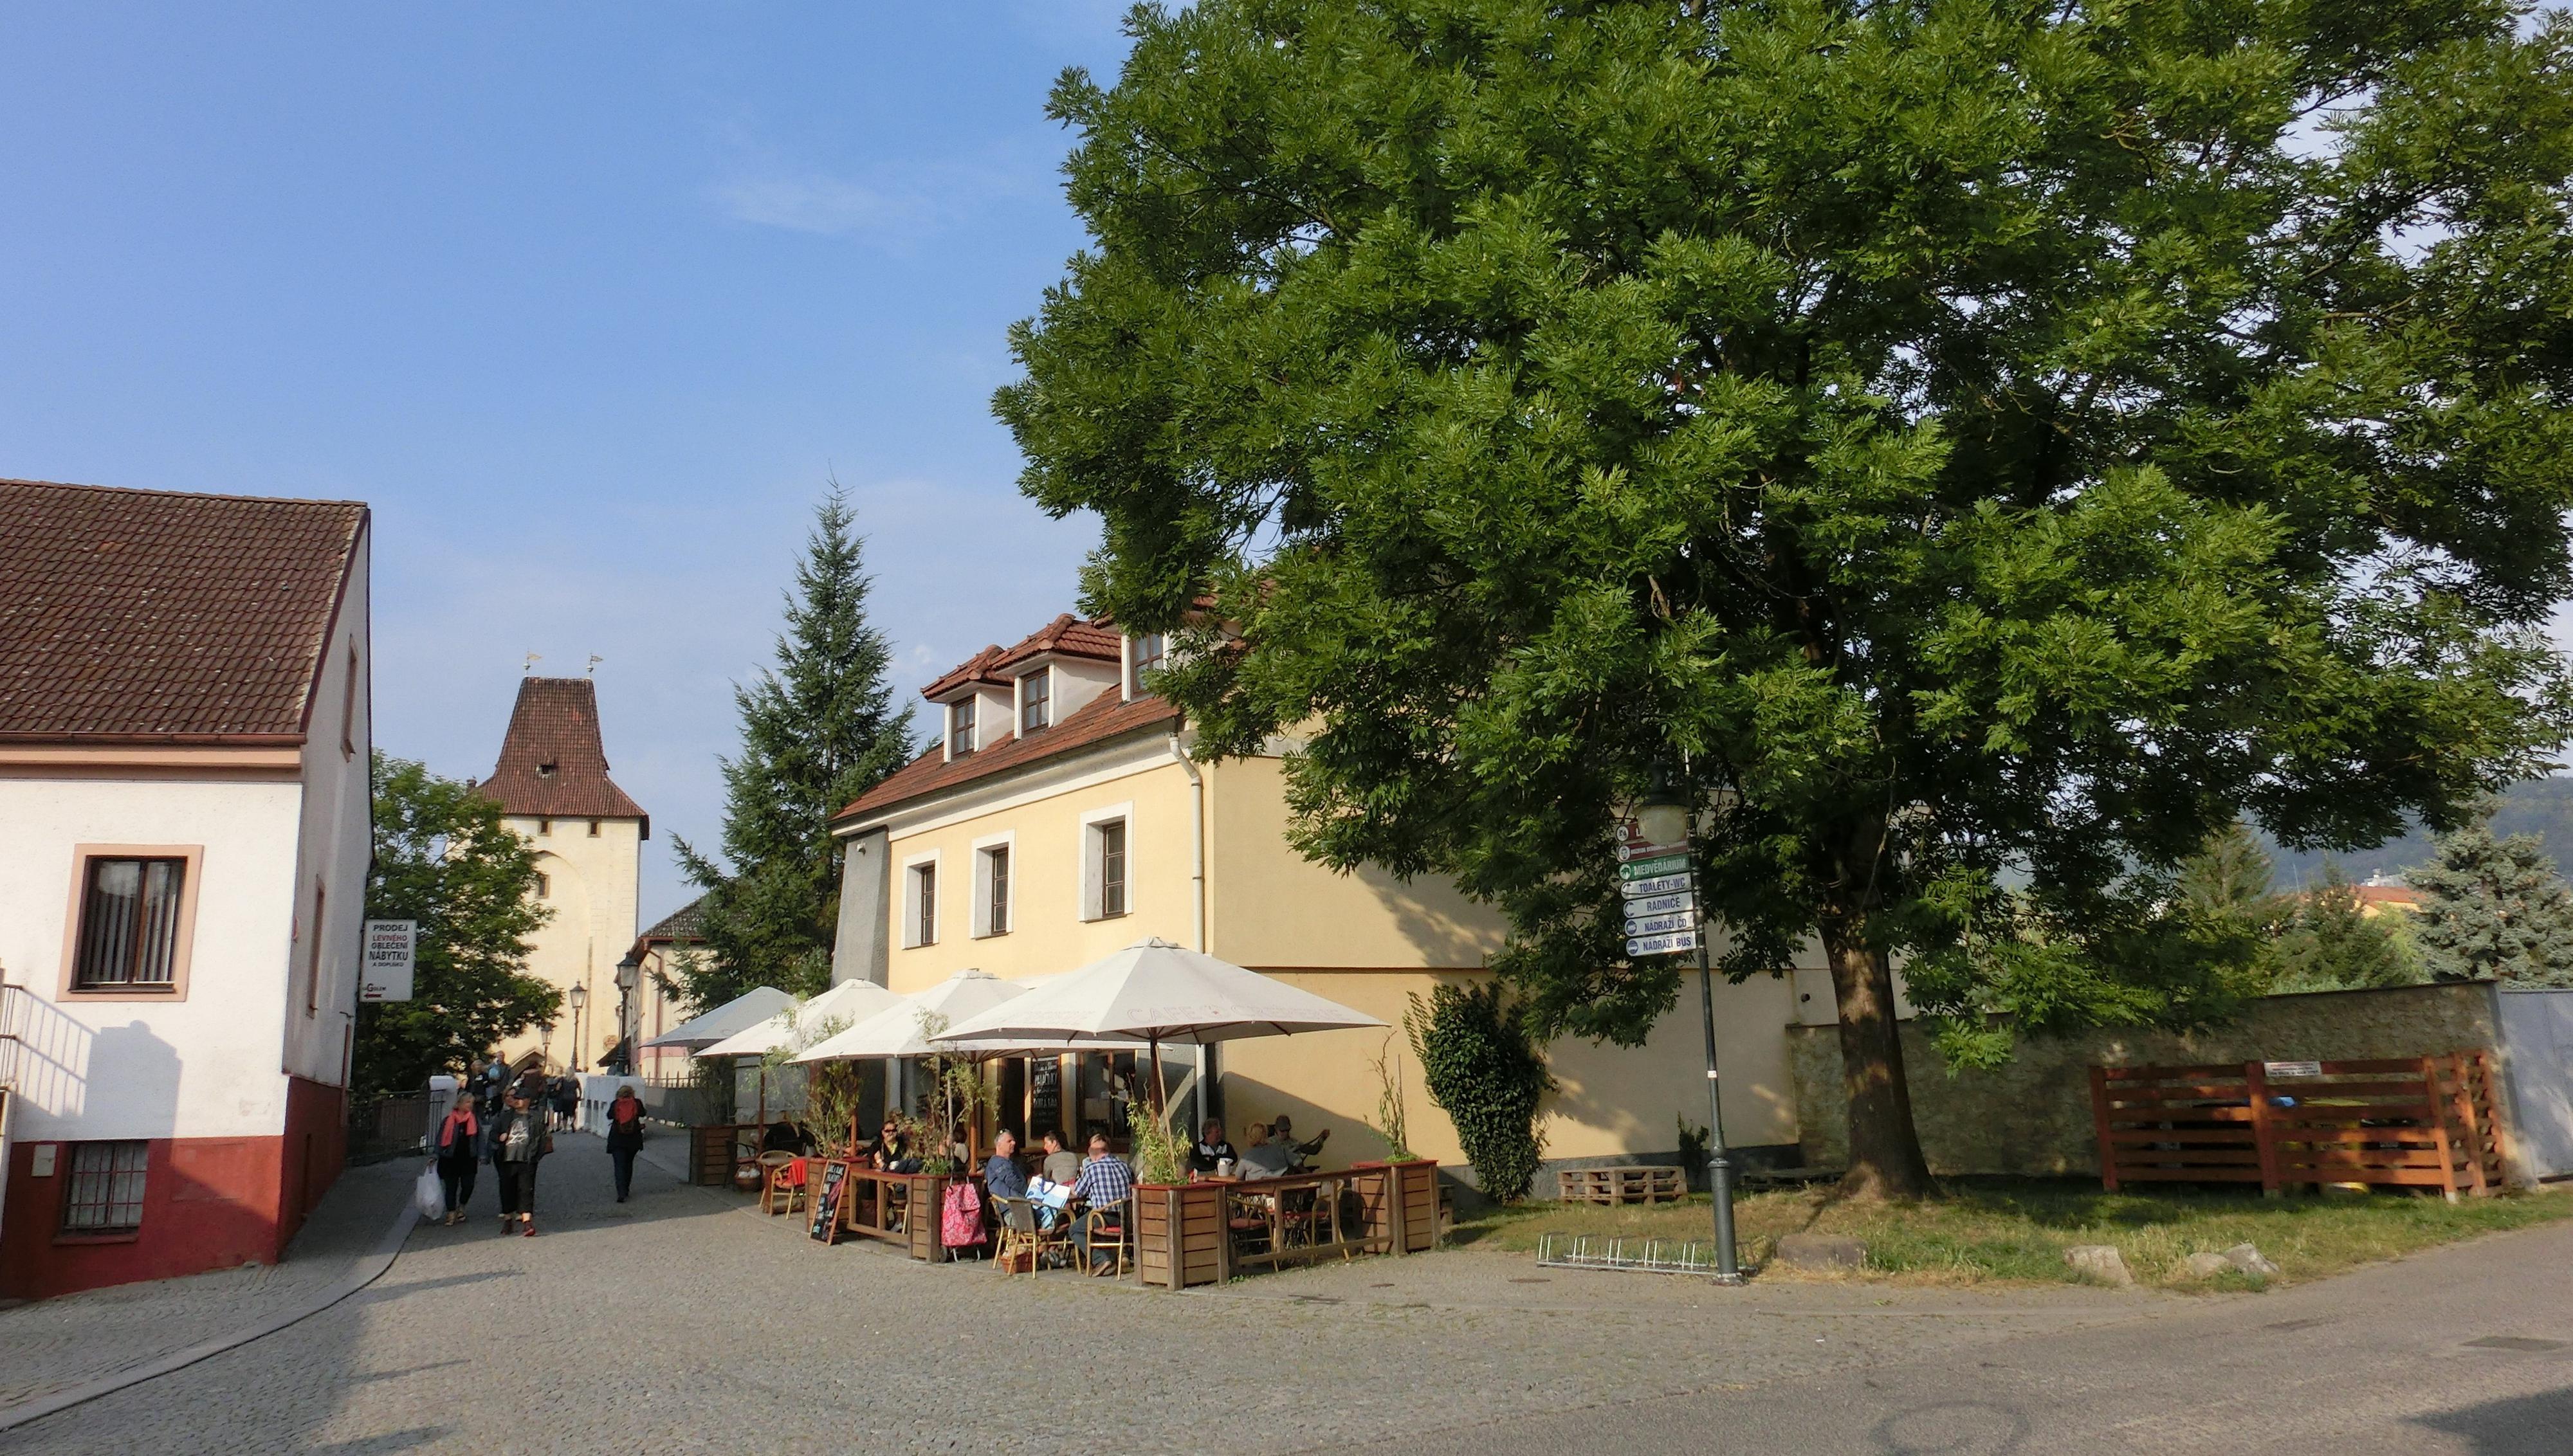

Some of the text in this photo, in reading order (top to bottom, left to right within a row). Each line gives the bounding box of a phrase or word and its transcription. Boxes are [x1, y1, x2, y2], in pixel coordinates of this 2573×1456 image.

[1633, 859, 1686, 876] MEDVĚDÁRIUM
[1639, 877, 1685, 893] TOALETY-WC
[1647, 896, 1681, 912] RADNICE
[1677, 915, 1687, 928] ČD
[373, 933, 408, 942] LEVNÉHO
[1676, 936, 1691, 947] BUS
[369, 950, 408, 961] NÁBYTKU
